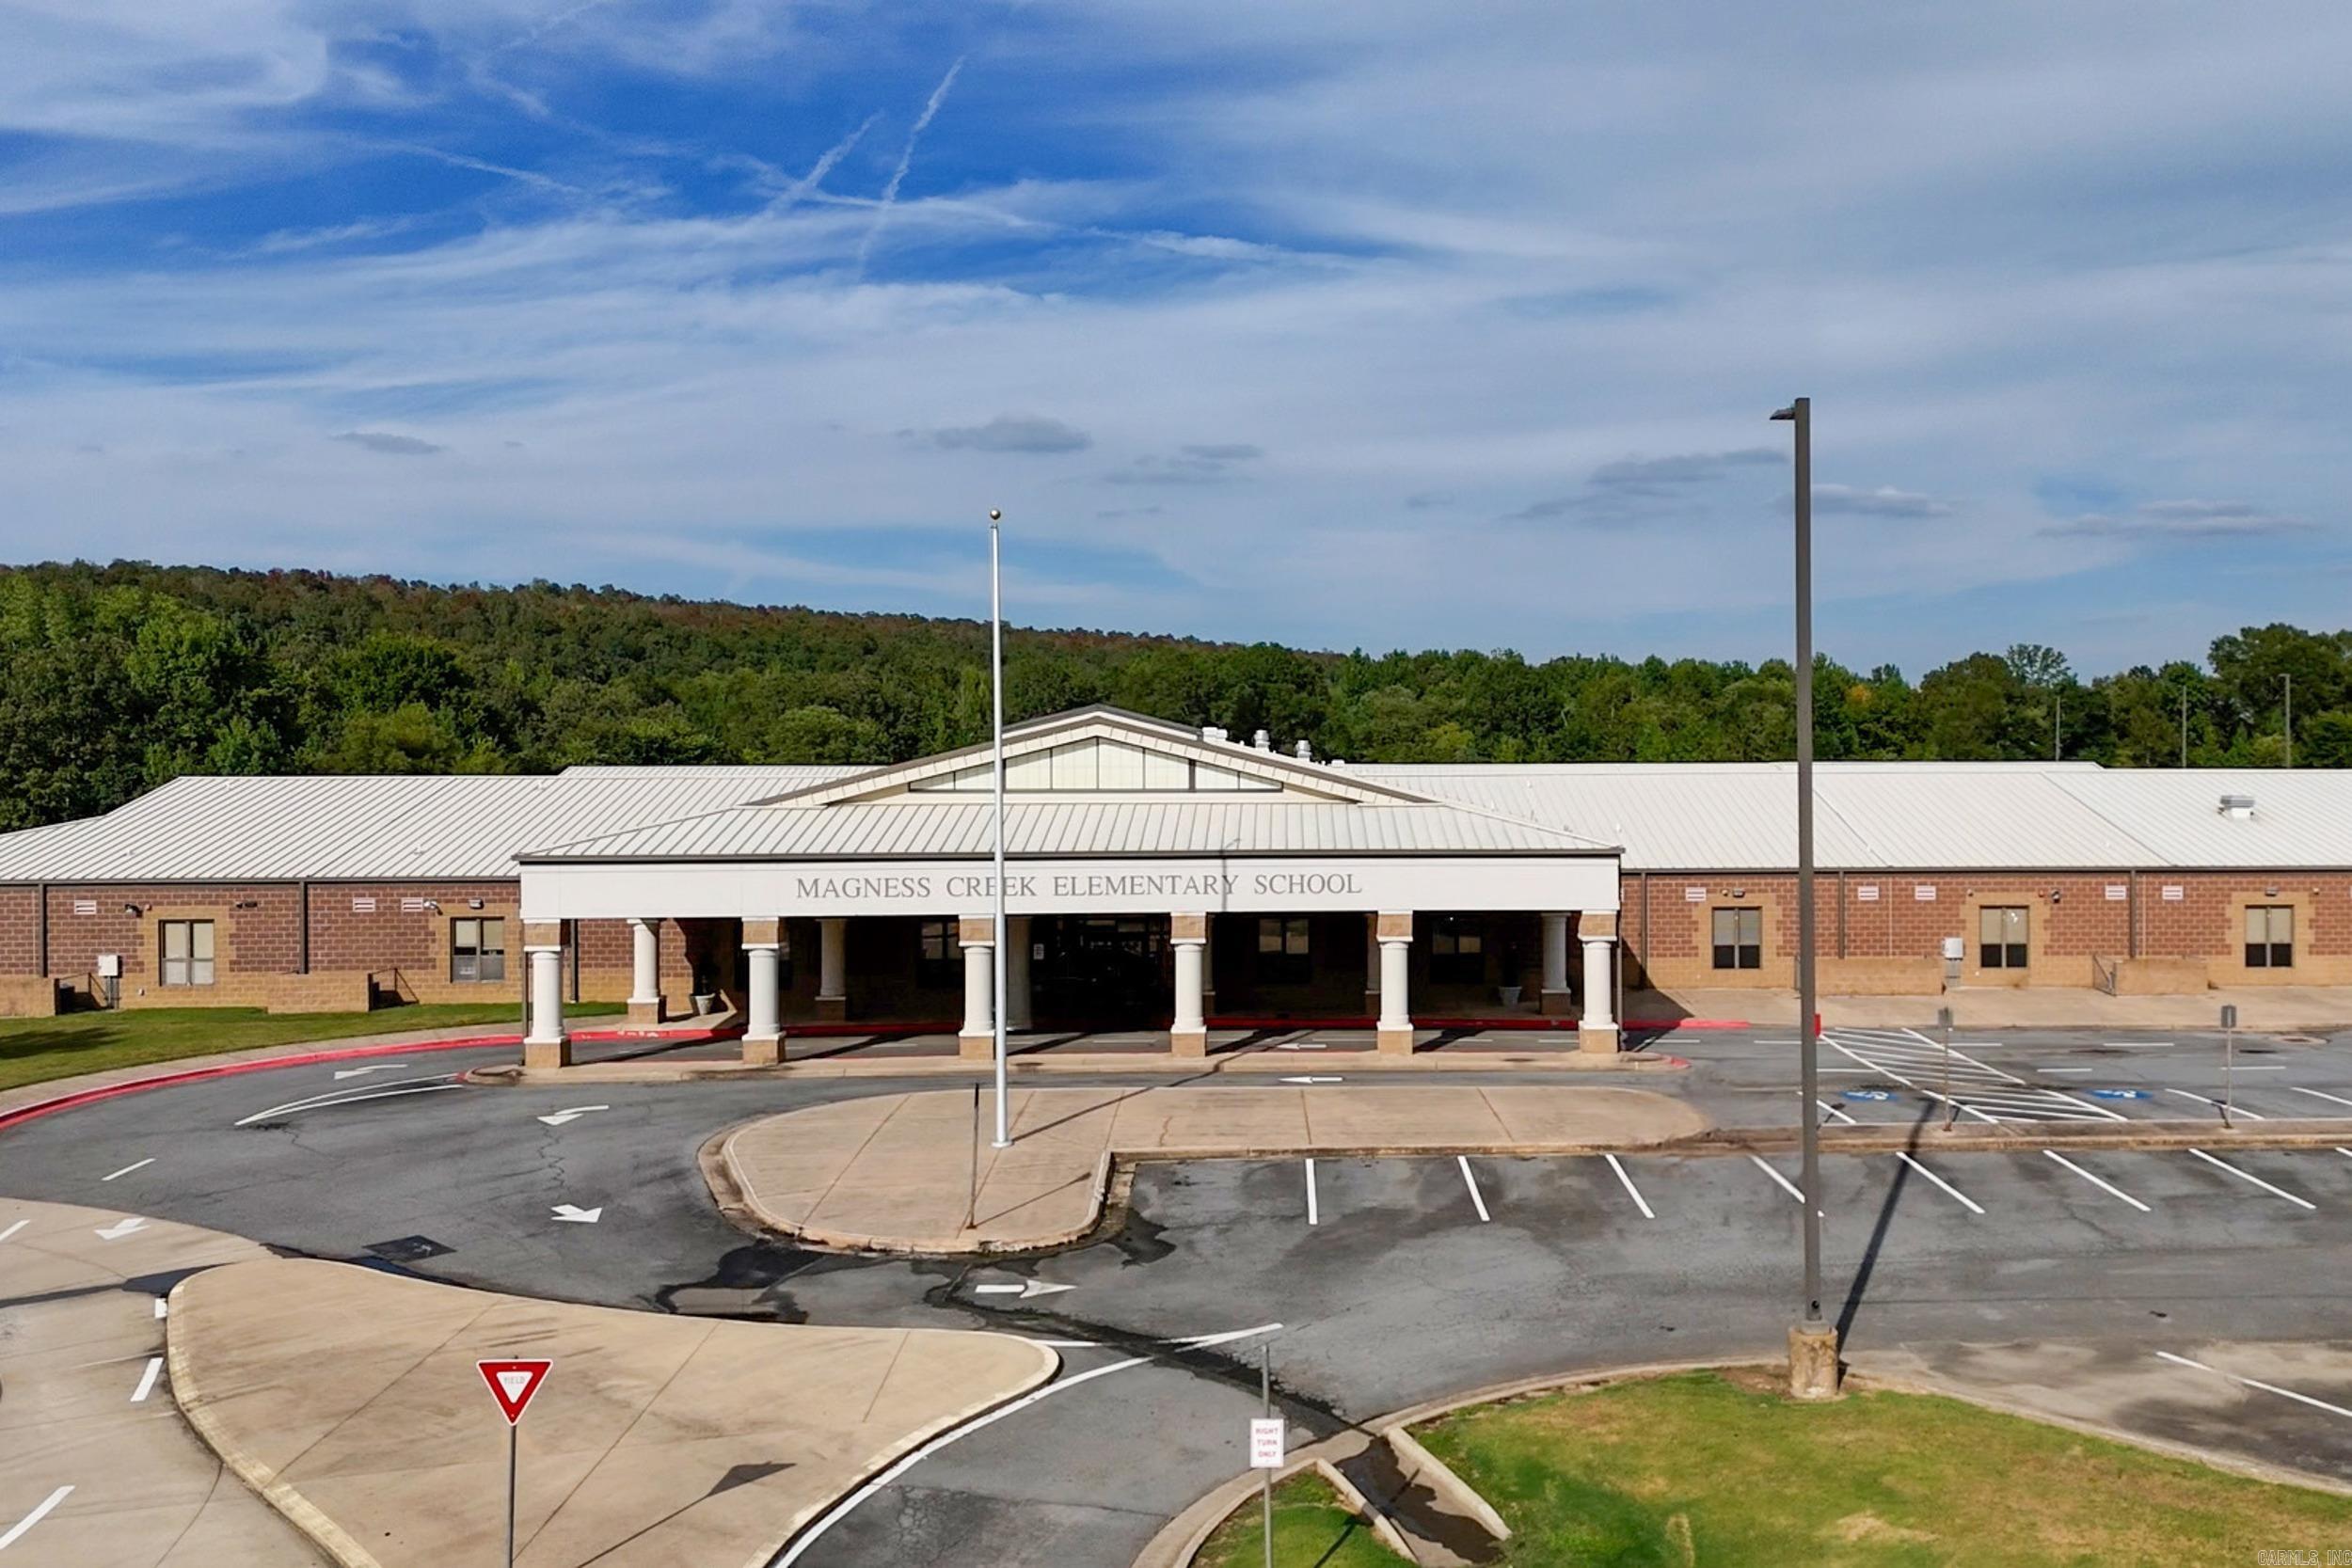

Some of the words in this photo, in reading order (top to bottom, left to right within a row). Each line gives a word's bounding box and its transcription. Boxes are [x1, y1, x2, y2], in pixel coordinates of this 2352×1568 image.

[796, 877, 931, 898] MAGNESS
[946, 876, 1038, 897] CREEK
[1052, 874, 1240, 897] ELEMENTARY
[1253, 873, 1363, 895] SCHOOL
